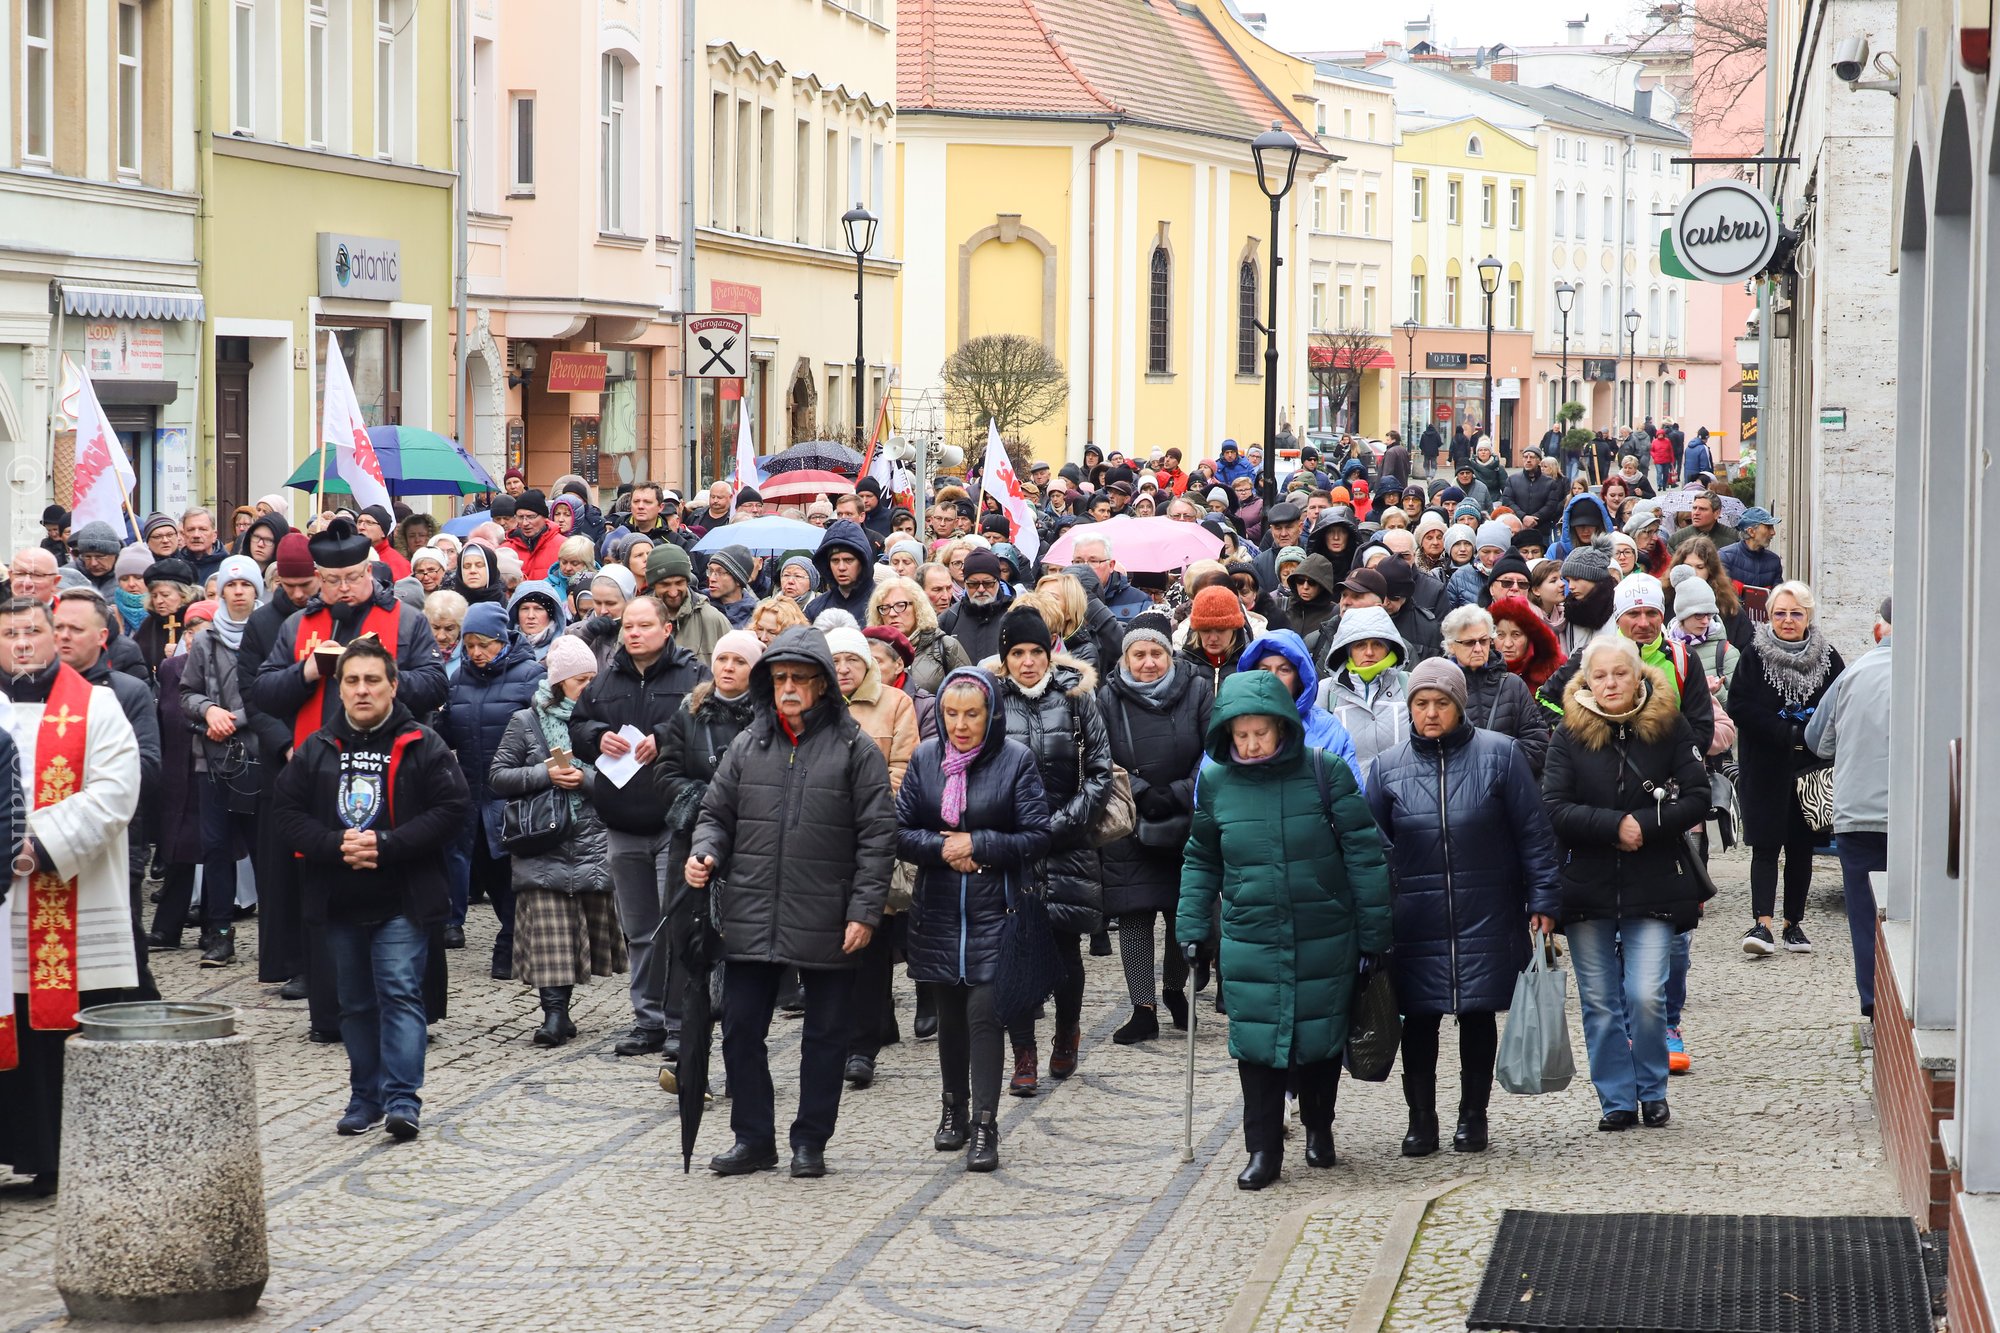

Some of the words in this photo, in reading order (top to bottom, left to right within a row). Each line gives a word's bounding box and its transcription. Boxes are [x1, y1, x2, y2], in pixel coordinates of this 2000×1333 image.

[1685, 214, 1765, 247] cukru
[351, 248, 397, 282] atlantic
[714, 286, 759, 305] Pierogarnia
[86, 324, 117, 342] LODY
[693, 320, 739, 331] Pierogarnia
[1434, 354, 1461, 363] OPTYK
[552, 357, 606, 386] Pierogarnia
[1625, 586, 1648, 598] DNB
